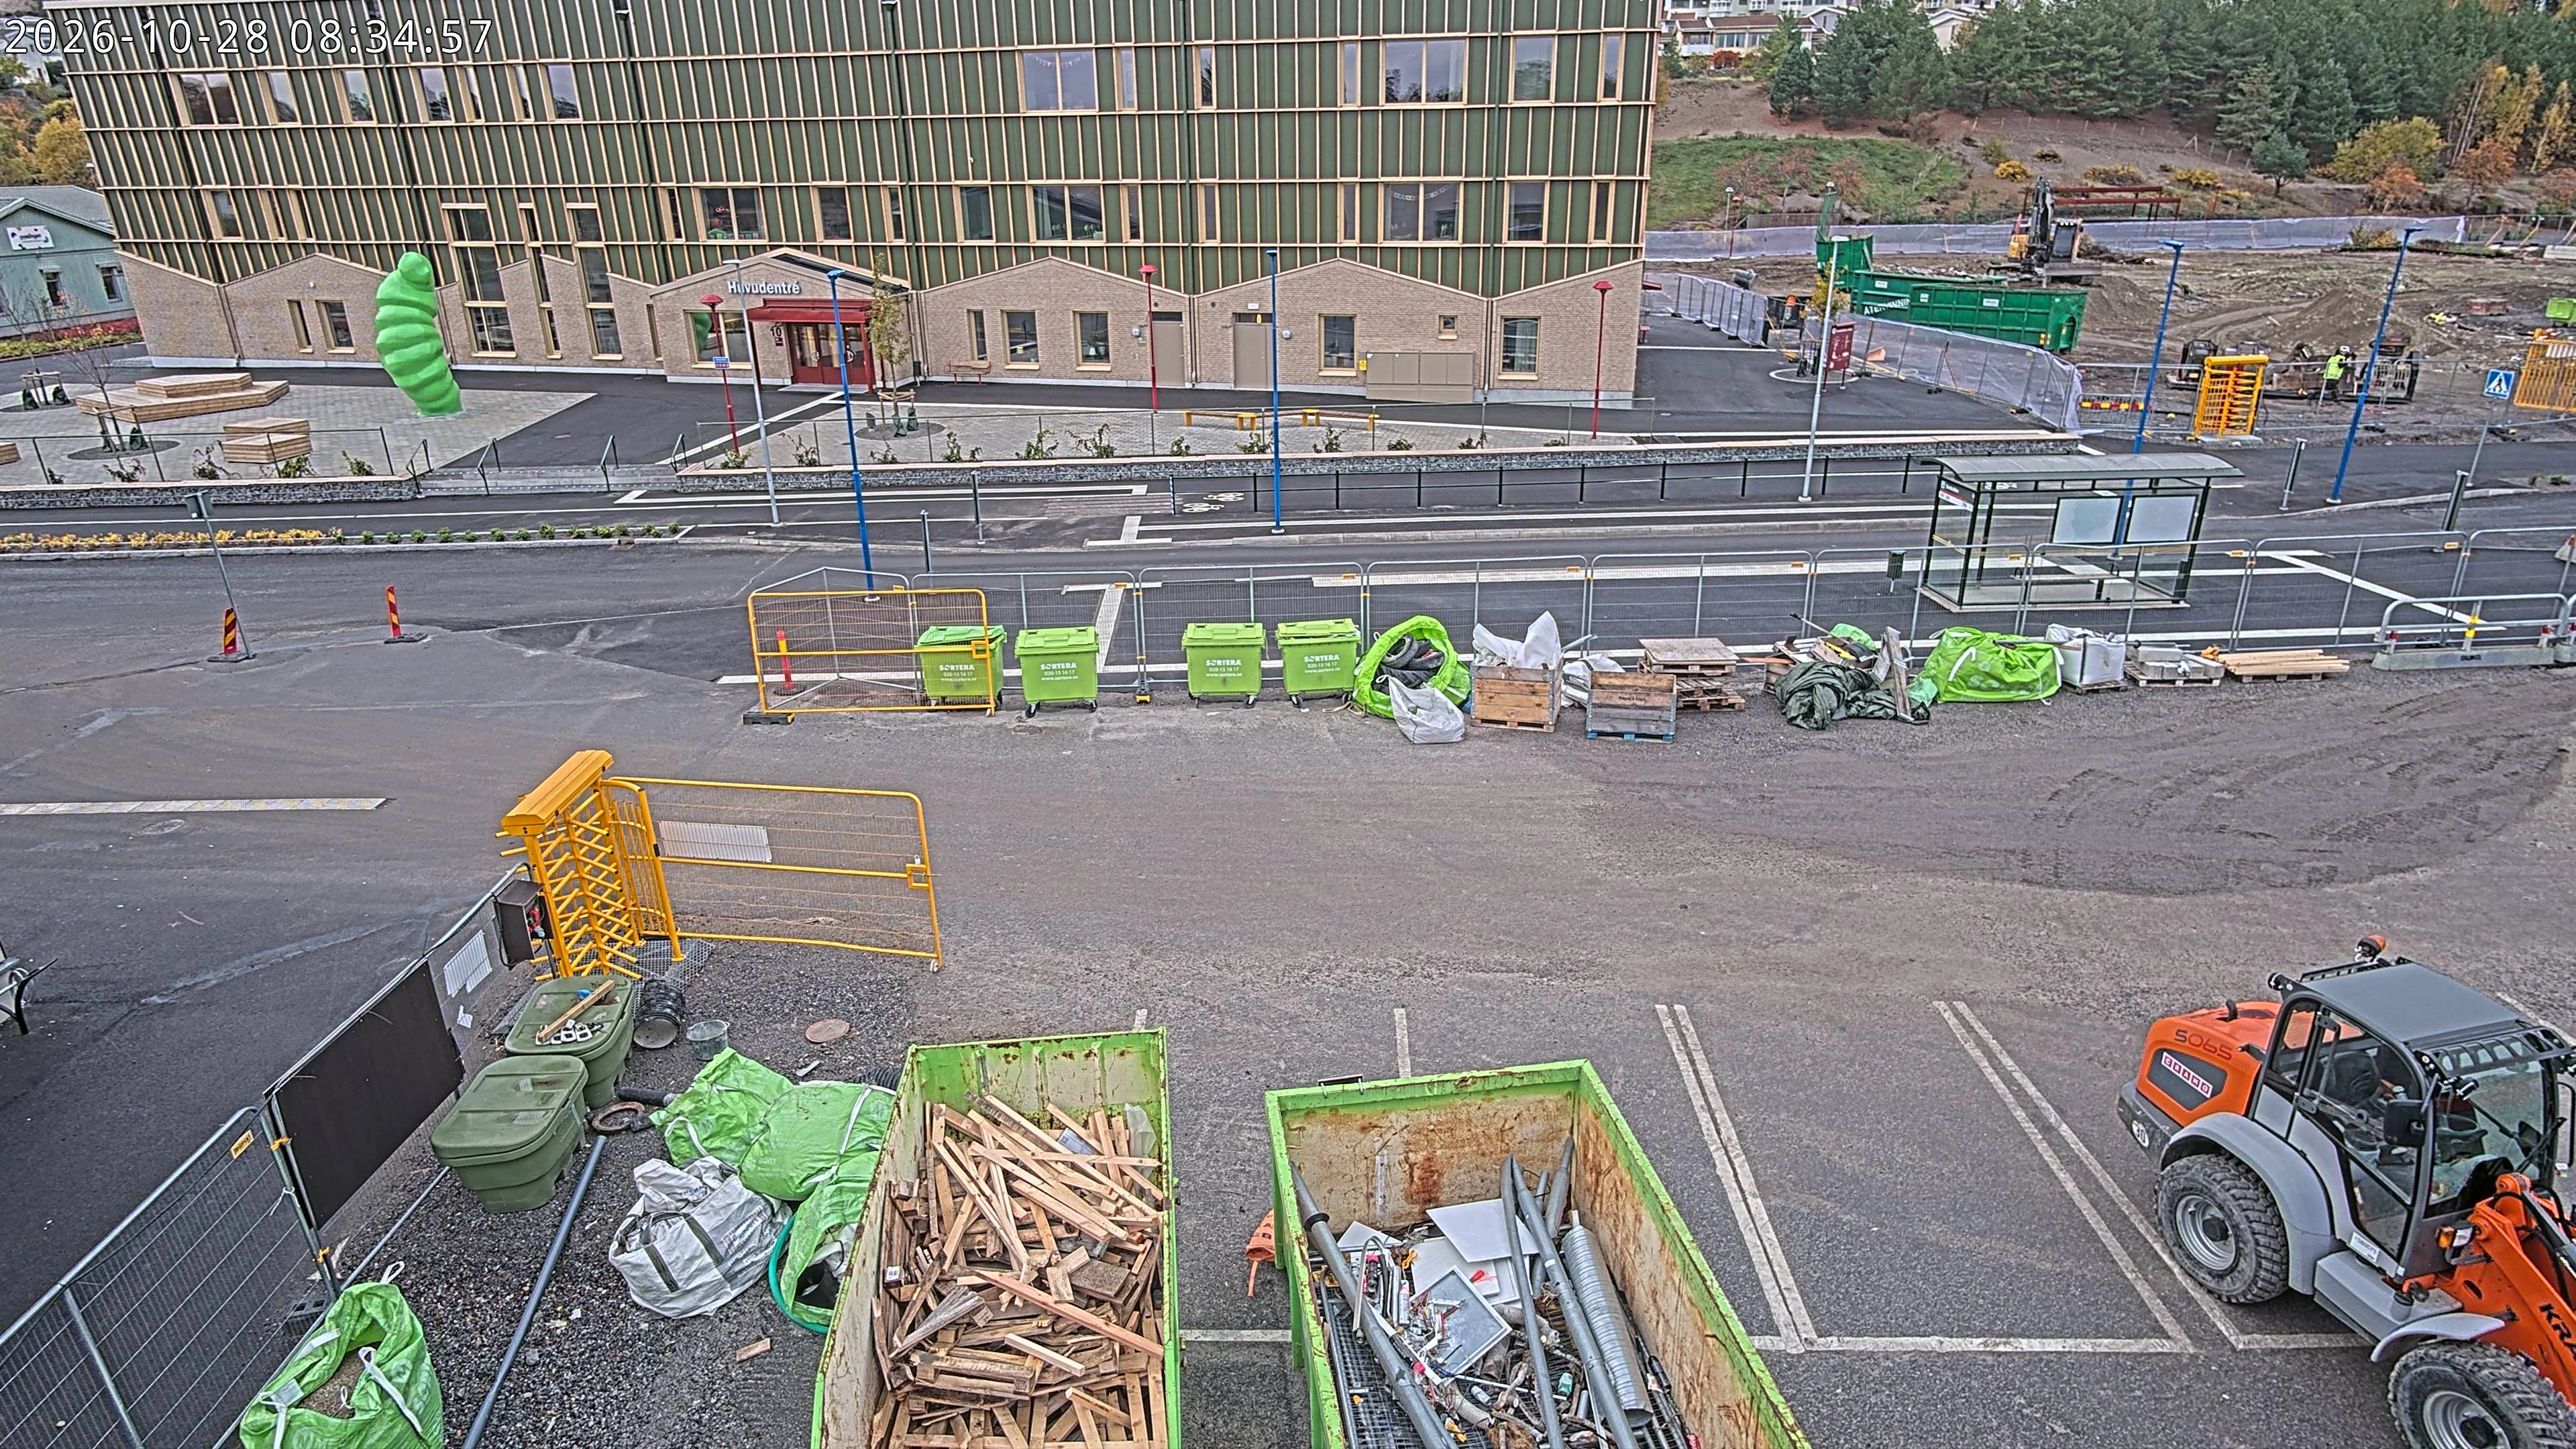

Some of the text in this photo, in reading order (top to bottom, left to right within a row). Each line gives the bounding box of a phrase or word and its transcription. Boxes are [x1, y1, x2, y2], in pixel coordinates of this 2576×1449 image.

[770, 327, 782, 337] 10
[1304, 654, 1340, 663] SORTERA
[1040, 662, 1077, 670] SORTERA
[2174, 1028, 2232, 1061] 5065
[2163, 1055, 2211, 1095] CRAMO
